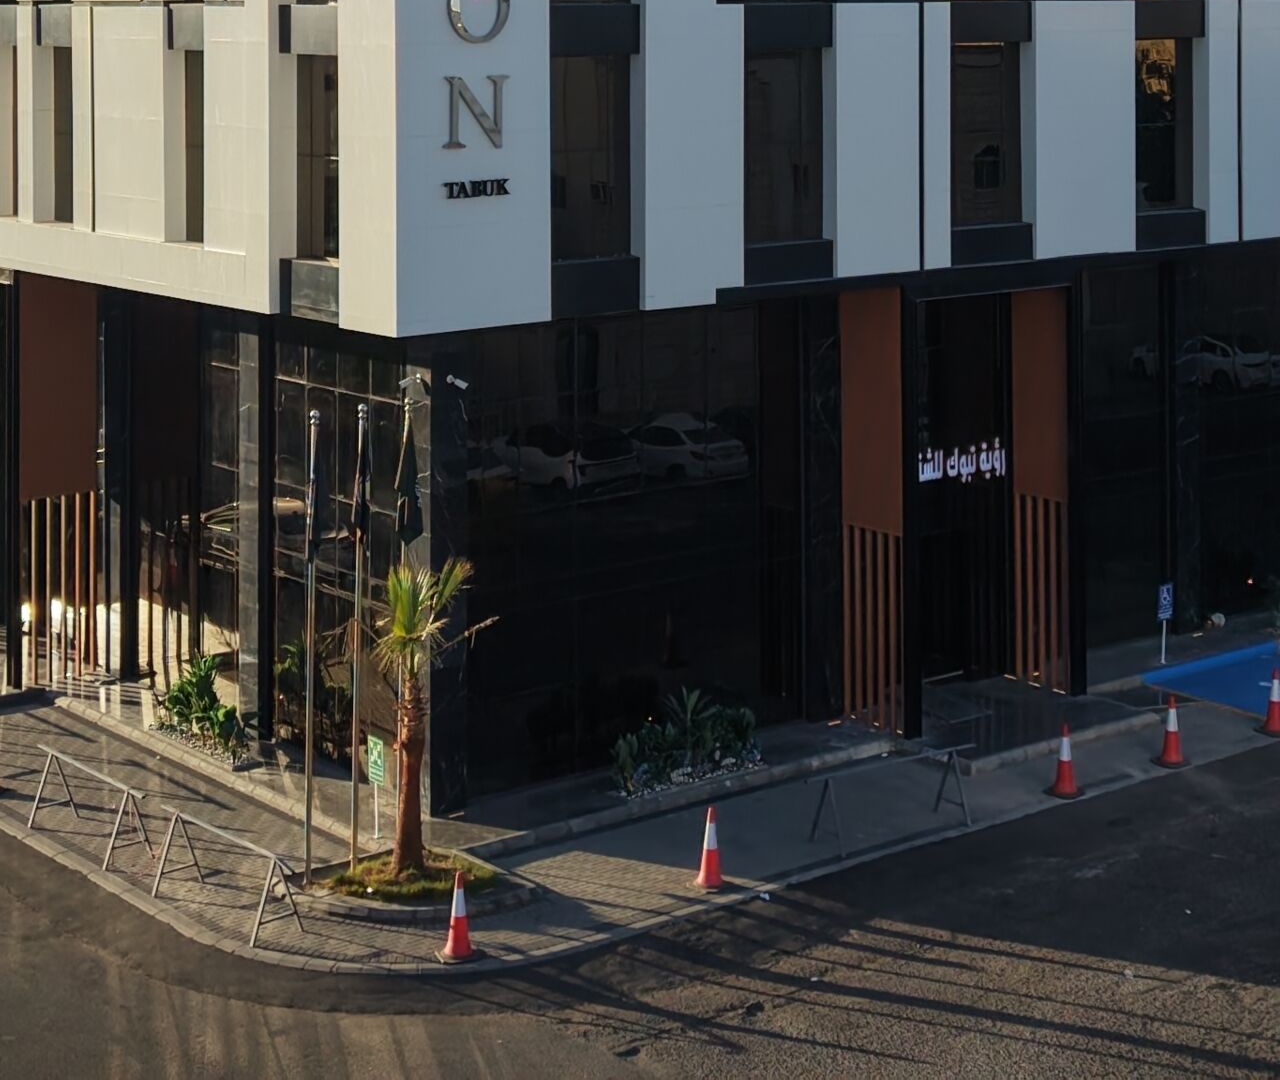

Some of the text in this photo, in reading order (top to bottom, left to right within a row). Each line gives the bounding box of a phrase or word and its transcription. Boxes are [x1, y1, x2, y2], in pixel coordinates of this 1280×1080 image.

[443, 178, 511, 200] TABUK
[946, 445, 976, 484] تبوك
[979, 436, 1006, 480] رؤية
